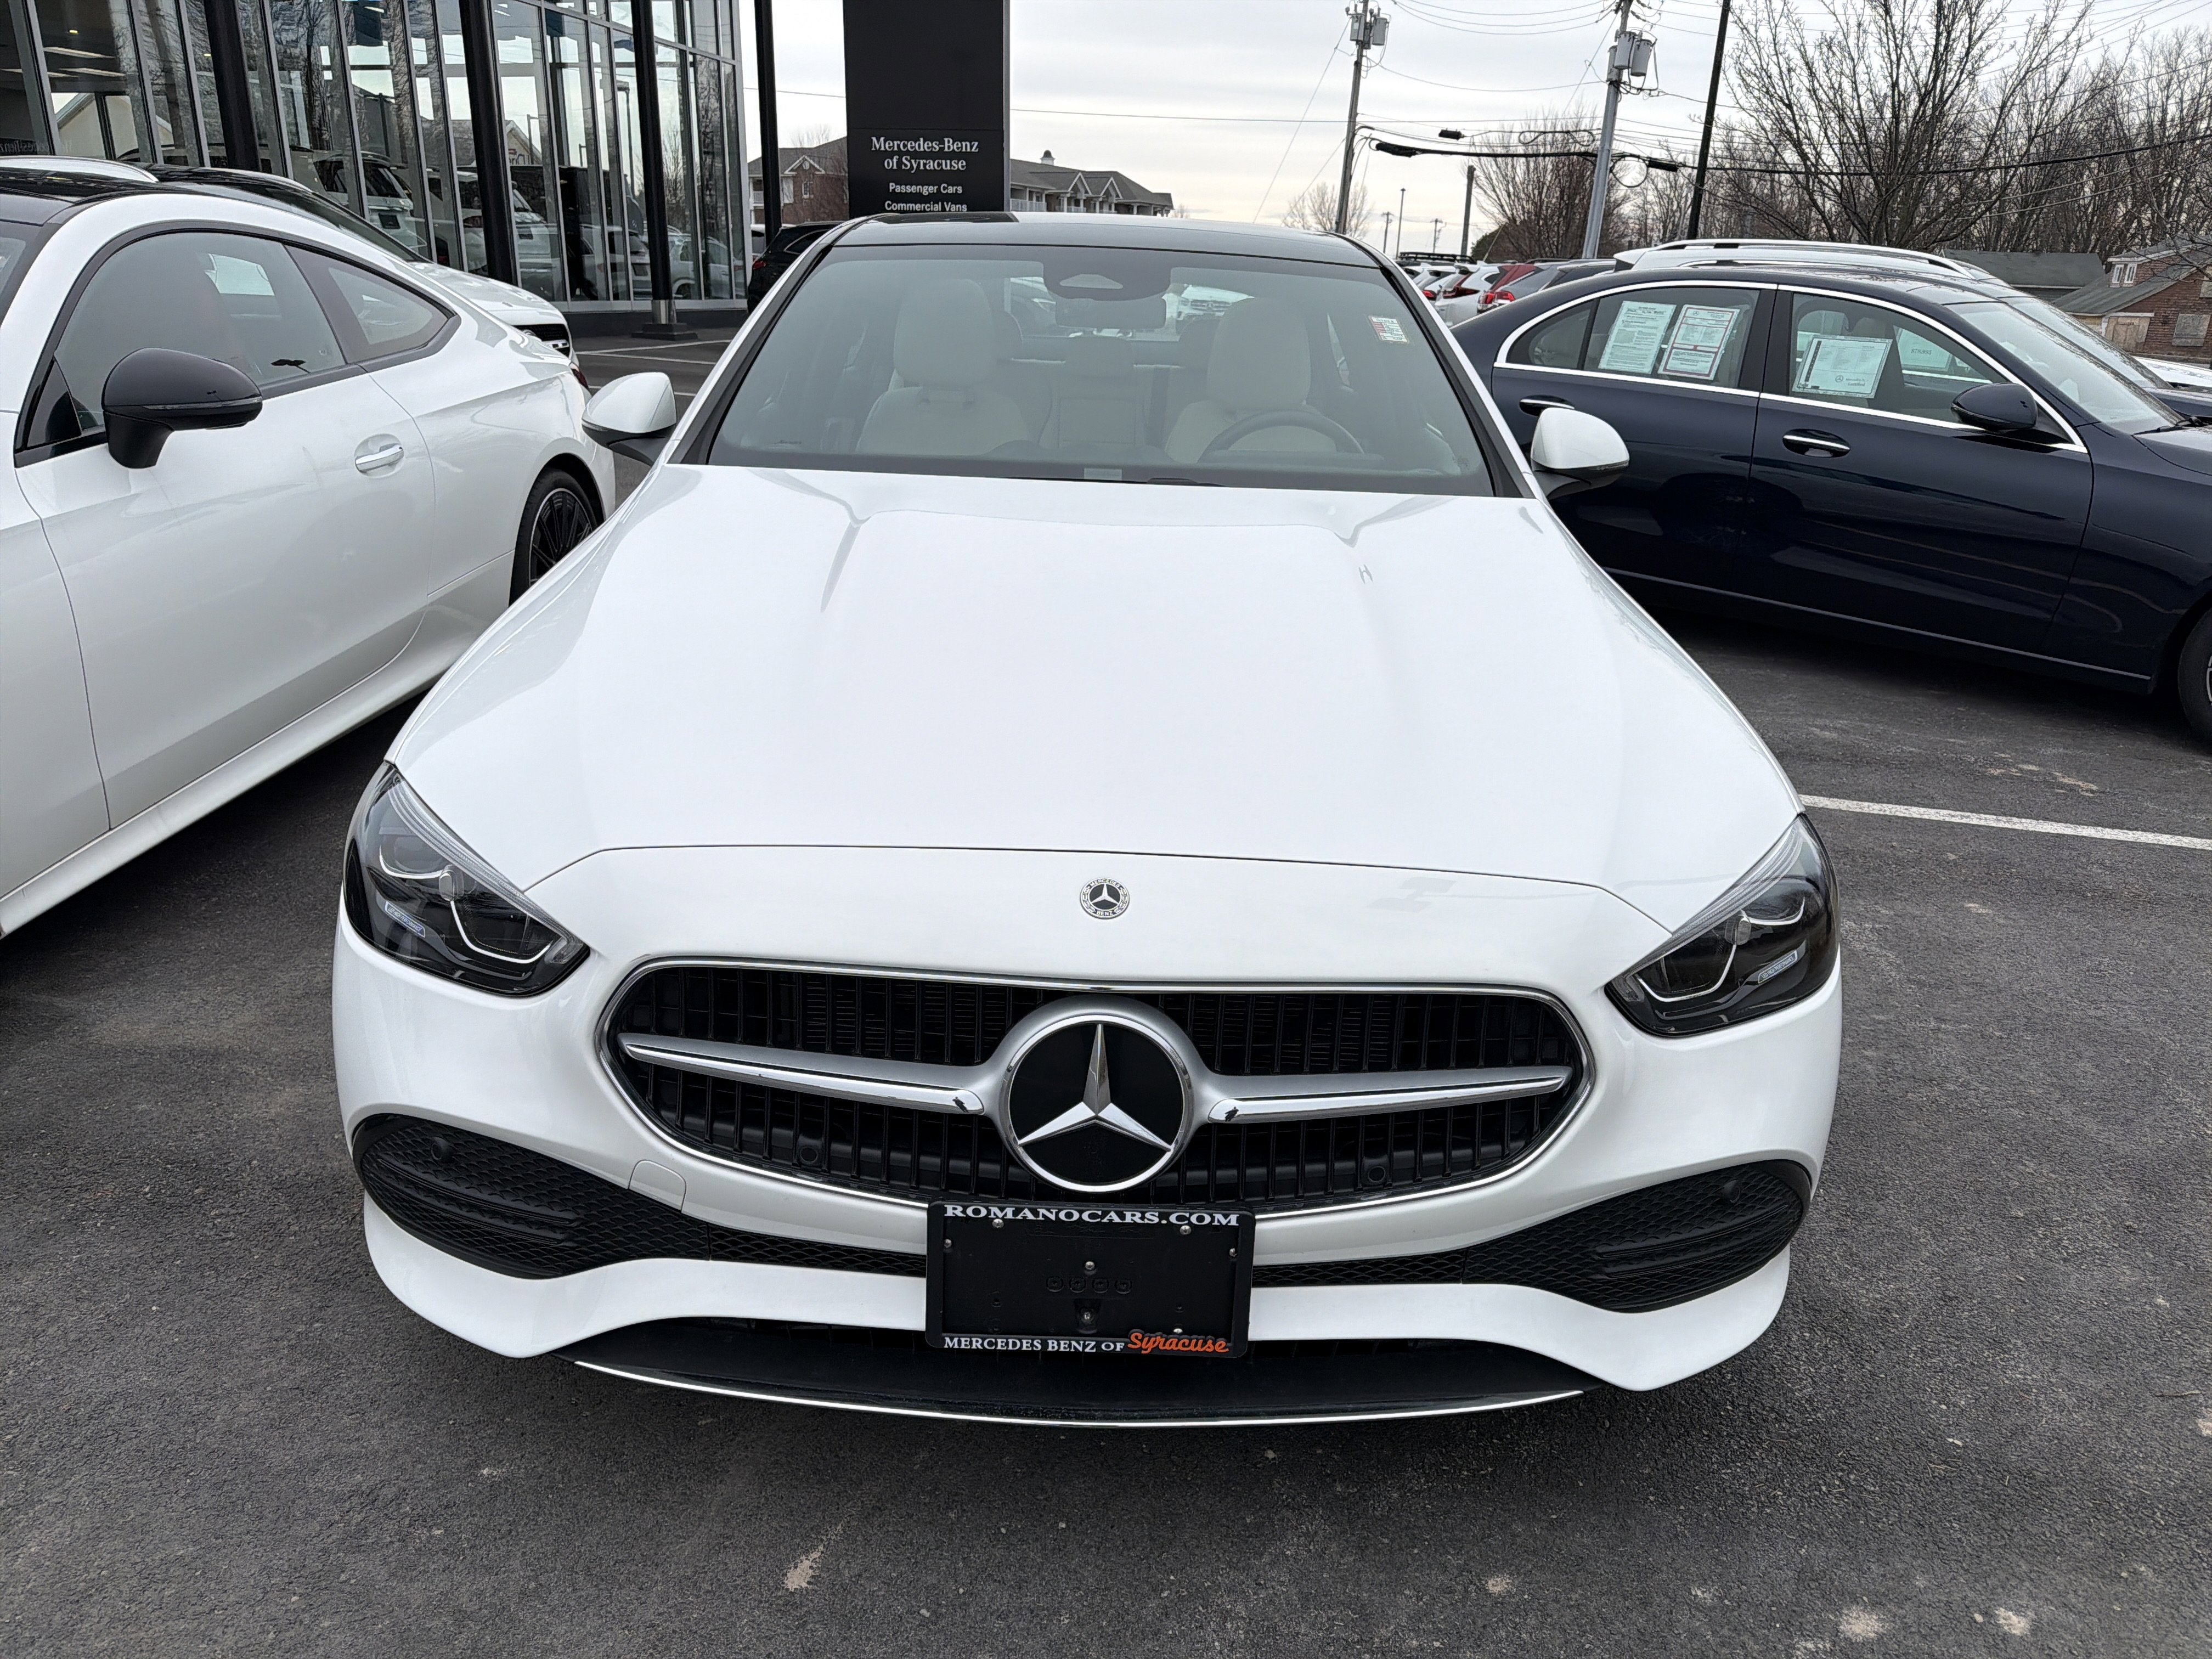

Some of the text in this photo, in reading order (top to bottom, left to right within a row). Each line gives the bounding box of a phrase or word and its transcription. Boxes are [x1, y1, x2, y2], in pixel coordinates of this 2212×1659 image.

[871, 137, 979, 152] Mercedes-Benz
[884, 156, 967, 173] of Syracuse
[889, 183, 962, 195] Passenger Cars
[885, 201, 967, 212] Commercial Vans
[1090, 879, 1120, 887] MERCEDES
[944, 1205, 1239, 1226] ROMANOCARS.COM
[944, 1332, 1229, 1354] MERCEDES BENZ OF Syracuse
